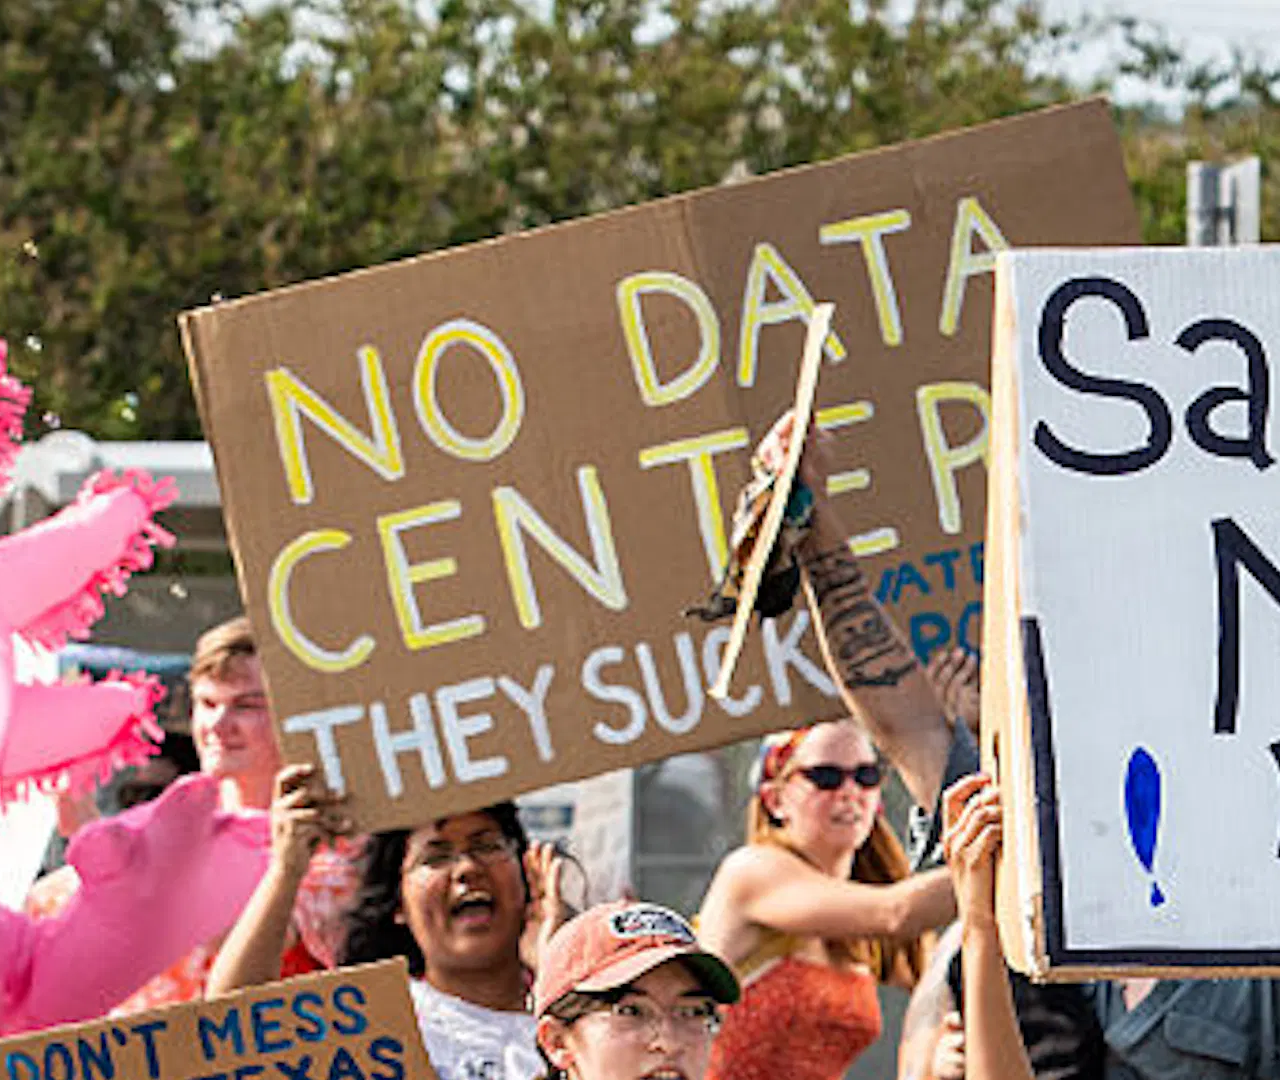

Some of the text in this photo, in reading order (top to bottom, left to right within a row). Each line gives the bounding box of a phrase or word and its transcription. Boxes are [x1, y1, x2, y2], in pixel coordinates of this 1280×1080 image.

[265, 196, 1011, 504] NO DATA
[282, 609, 842, 799] THEY SUCK
[197, 985, 369, 1062] MESS
